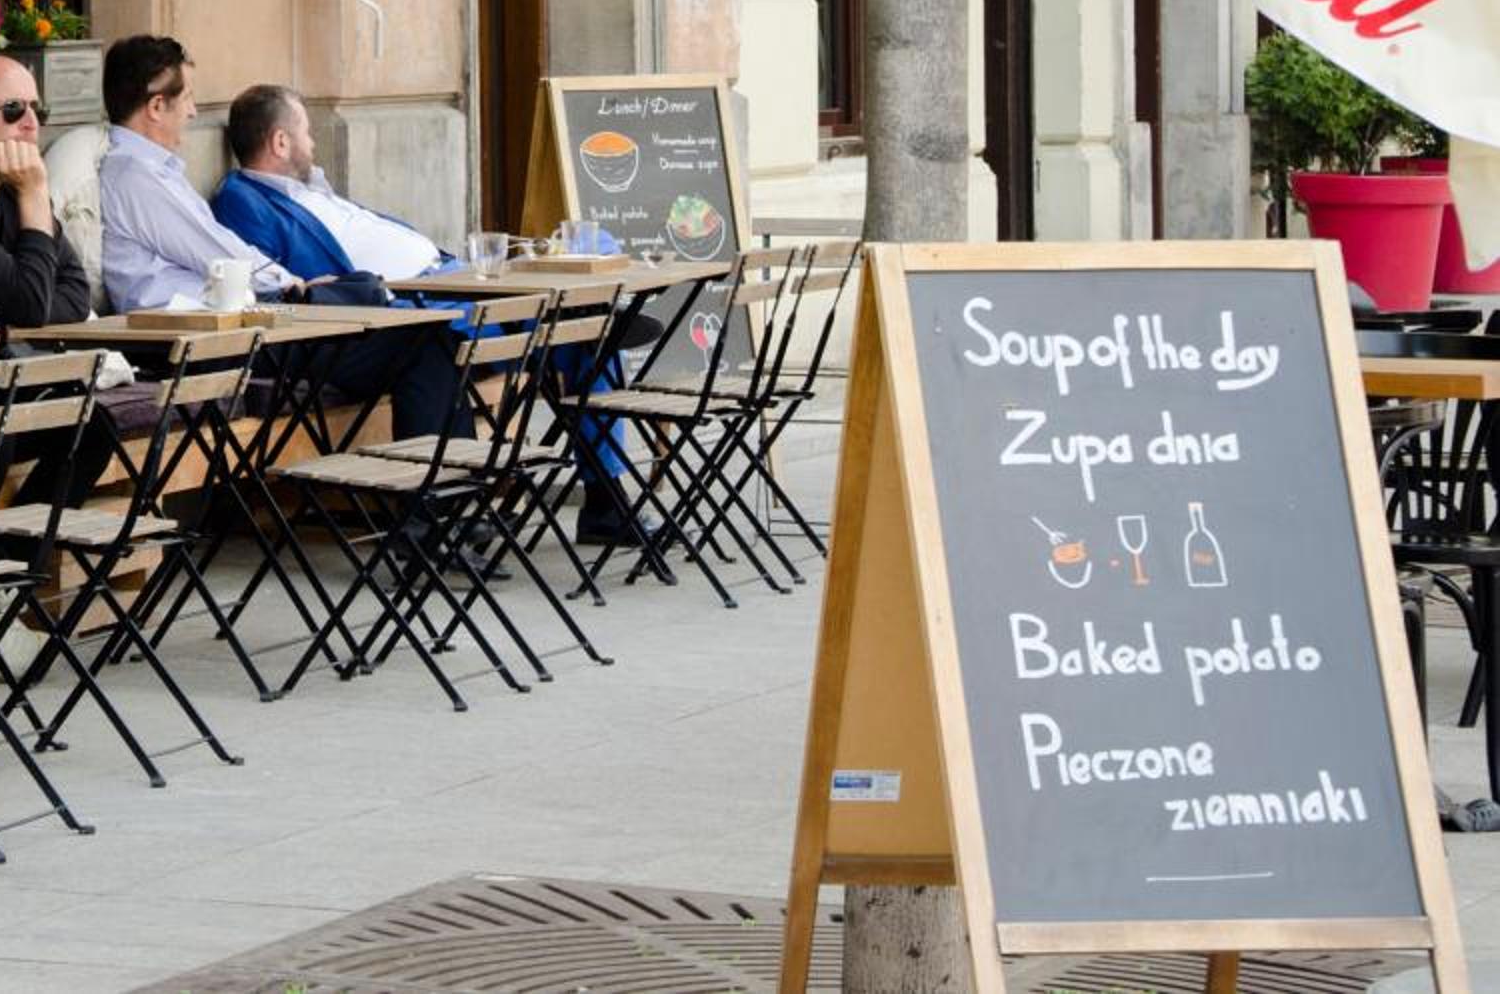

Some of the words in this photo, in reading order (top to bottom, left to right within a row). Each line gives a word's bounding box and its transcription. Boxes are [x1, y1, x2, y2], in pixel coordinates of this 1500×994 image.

[963, 297, 1083, 396] Soup
[1087, 314, 1134, 389] of
[1137, 313, 1203, 370] the
[1210, 310, 1280, 391] day
[1000, 409, 1134, 503] Zupa
[1147, 410, 1240, 465] dnia
[1008, 612, 1162, 679] Baked
[1185, 613, 1322, 706] potato
[1020, 712, 1214, 790] Pieczone
[1164, 770, 1369, 832] ziemniaki
